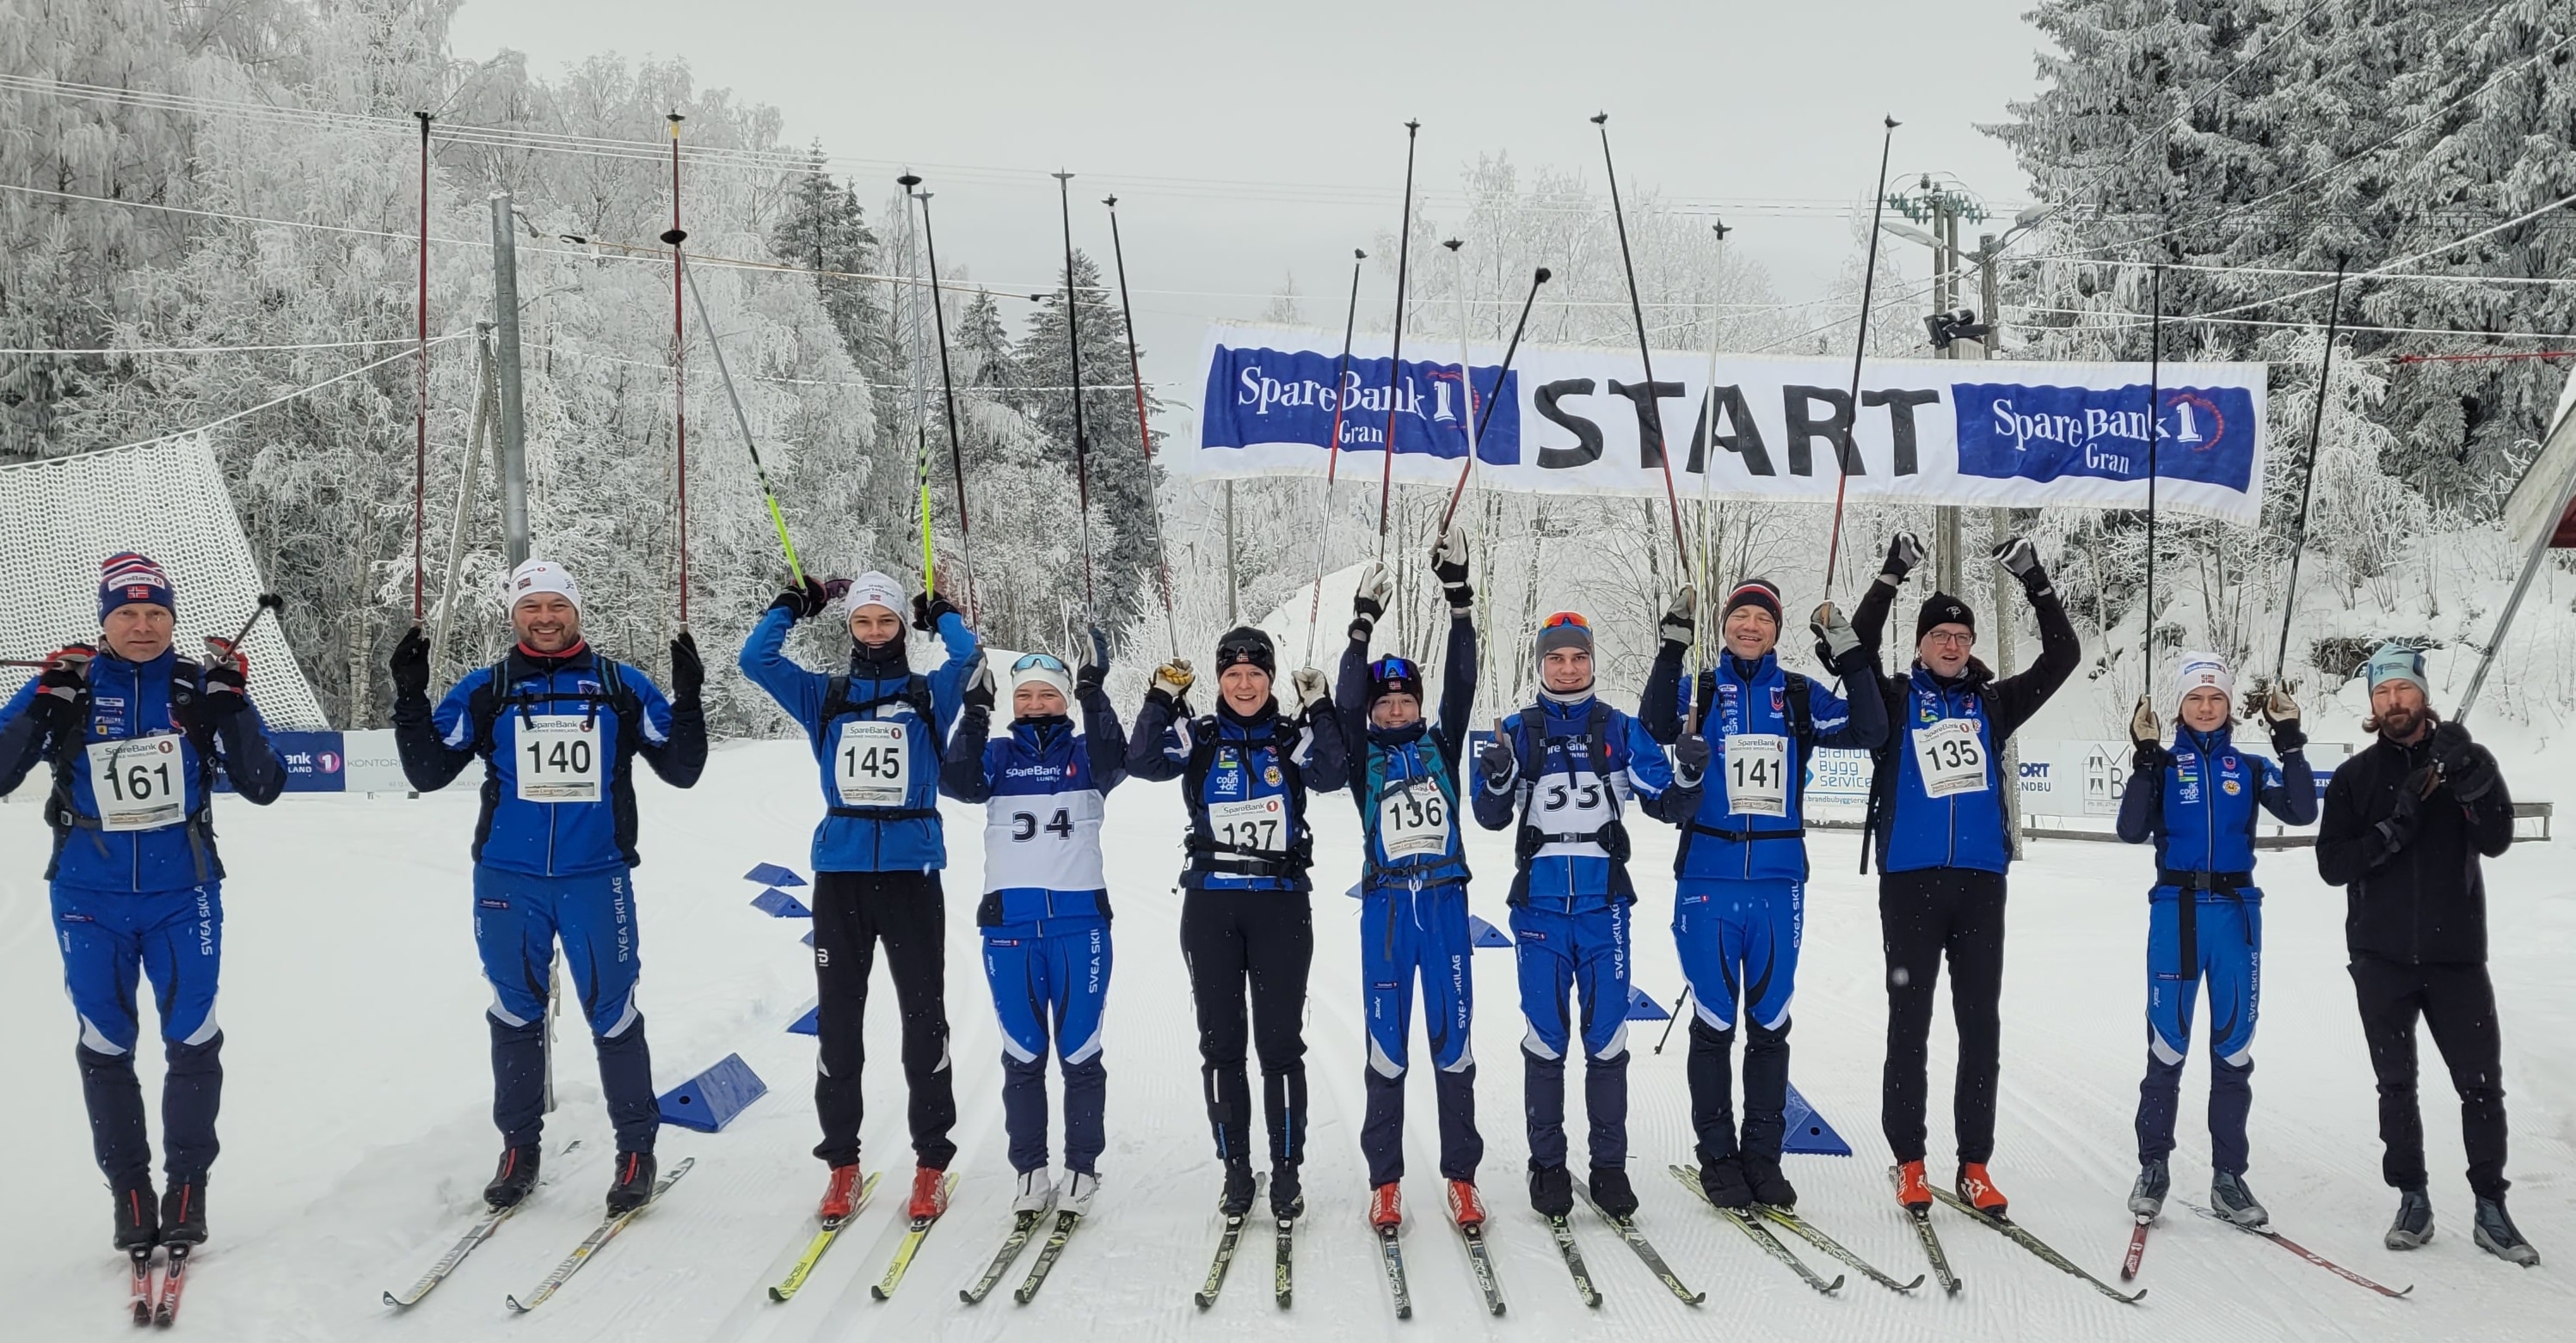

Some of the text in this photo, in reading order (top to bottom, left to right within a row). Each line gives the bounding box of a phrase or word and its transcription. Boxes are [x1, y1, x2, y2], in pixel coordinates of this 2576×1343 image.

[1239, 366, 1425, 420] SpareBank
[1337, 420, 1384, 445] Gran
[1534, 377, 1940, 477] START
[1994, 397, 2204, 452] SpareBank 1
[2086, 443, 2130, 475] Gran
[532, 721, 578, 729] SpareBank
[850, 727, 890, 735] SpareBank
[526, 739, 591, 774] 140
[844, 745, 900, 780] 145
[1005, 764, 1061, 778] SpareBank
[1819, 760, 1859, 776] Bygg
[1925, 739, 1979, 771] 135
[2019, 762, 2050, 778] ORT
[103, 762, 170, 801] 161
[1732, 757, 1780, 789] 141
[2020, 782, 2051, 792] NDBU
[1389, 797, 1442, 831] 136
[1222, 819, 1278, 851] 137
[1791, 880, 1800, 911] SKIL
[194, 885, 213, 955] SVEA SKILA
[612, 876, 629, 963] SVEA SKILAG
[1088, 956, 1101, 994] SVEA
